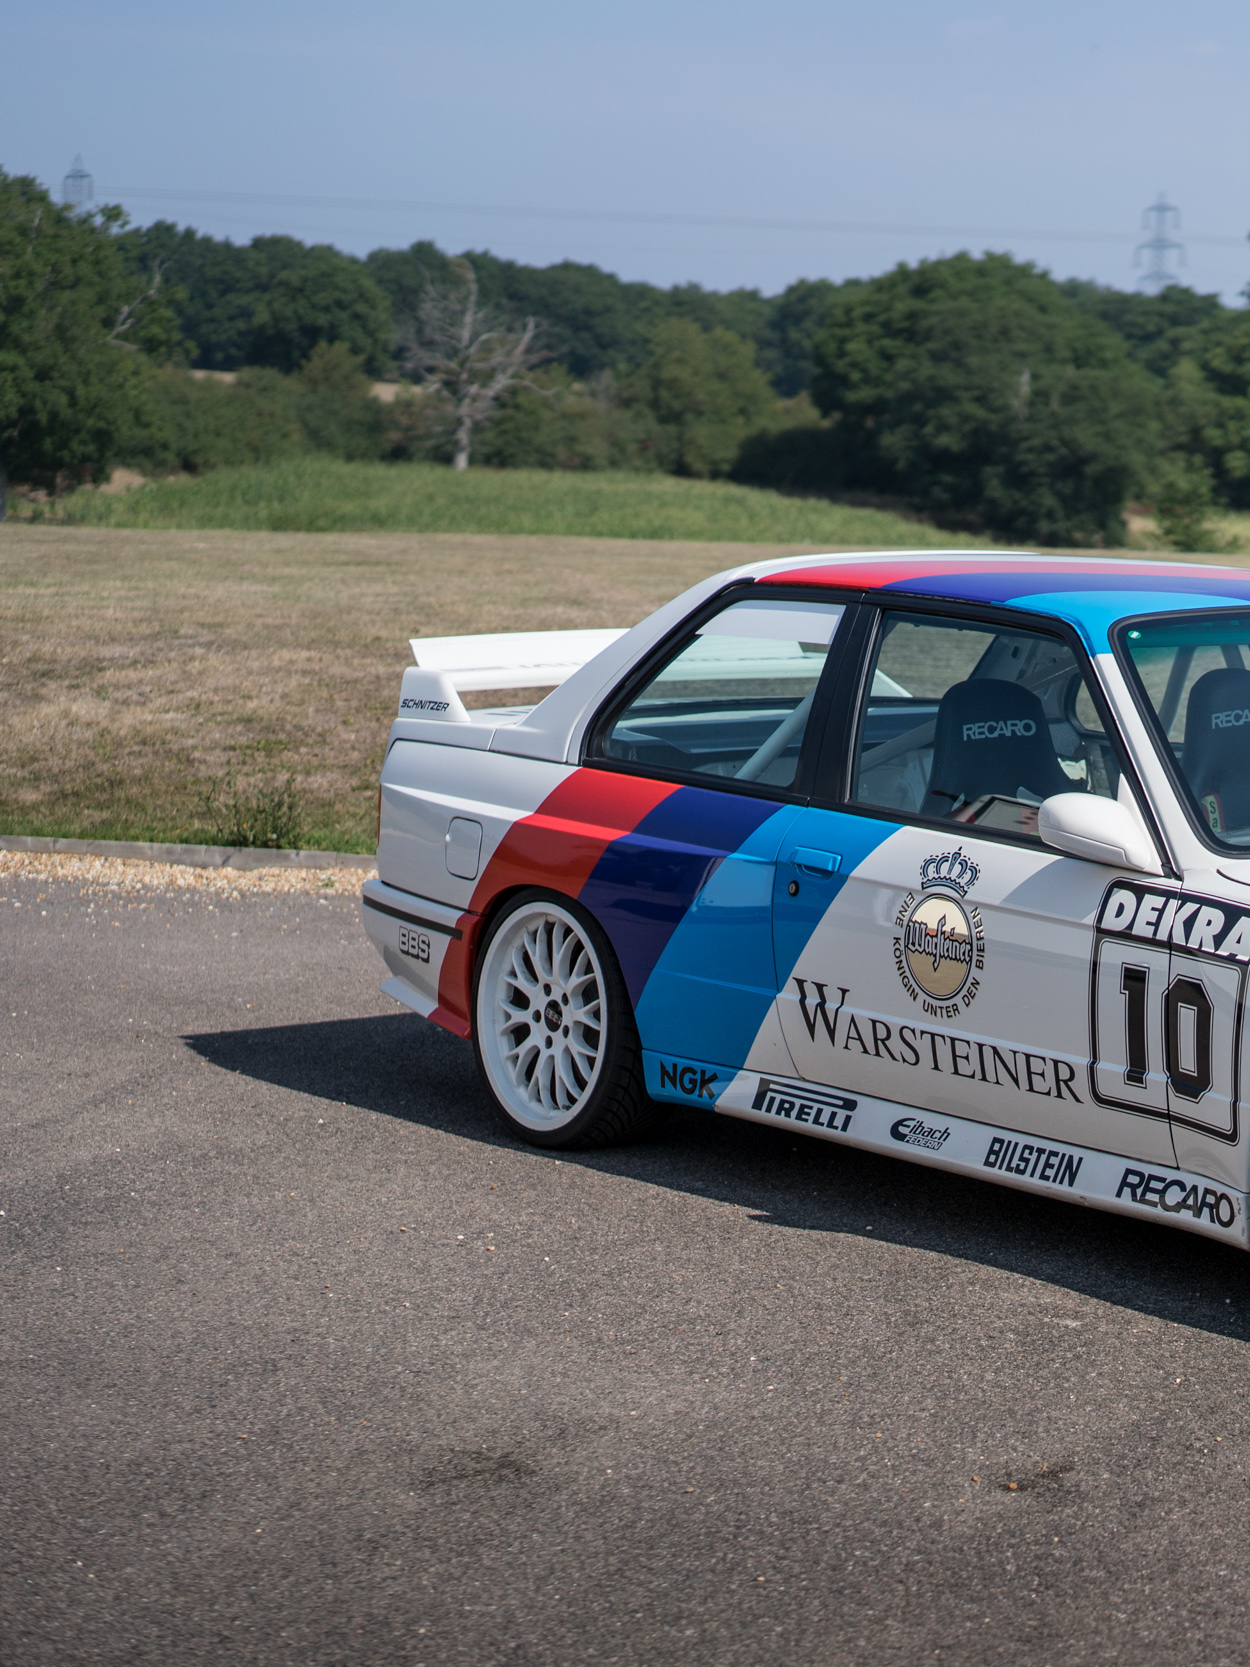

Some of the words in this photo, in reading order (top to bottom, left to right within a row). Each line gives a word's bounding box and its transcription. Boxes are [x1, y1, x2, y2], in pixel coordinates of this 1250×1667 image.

[400, 698, 450, 712] SCHNITZER
[963, 719, 1036, 741] RECARO
[895, 892, 915, 928] EINE
[399, 926, 432, 963] BBS
[970, 906, 985, 971] BIEREN
[893, 937, 919, 1002] KÖNIGIN
[922, 999, 961, 1019] UNTER
[961, 976, 981, 1008] DEN
[792, 977, 1085, 1104] WARSTEINER
[1119, 961, 1214, 1104] 10
[659, 1060, 719, 1100] NGK
[751, 1077, 858, 1133] PIRELLI
[890, 1117, 951, 1142] Eibach
[904, 1134, 944, 1151] FEDERN
[983, 1136, 1083, 1187] BILSTEIN
[1115, 1167, 1235, 1228] RECARO
